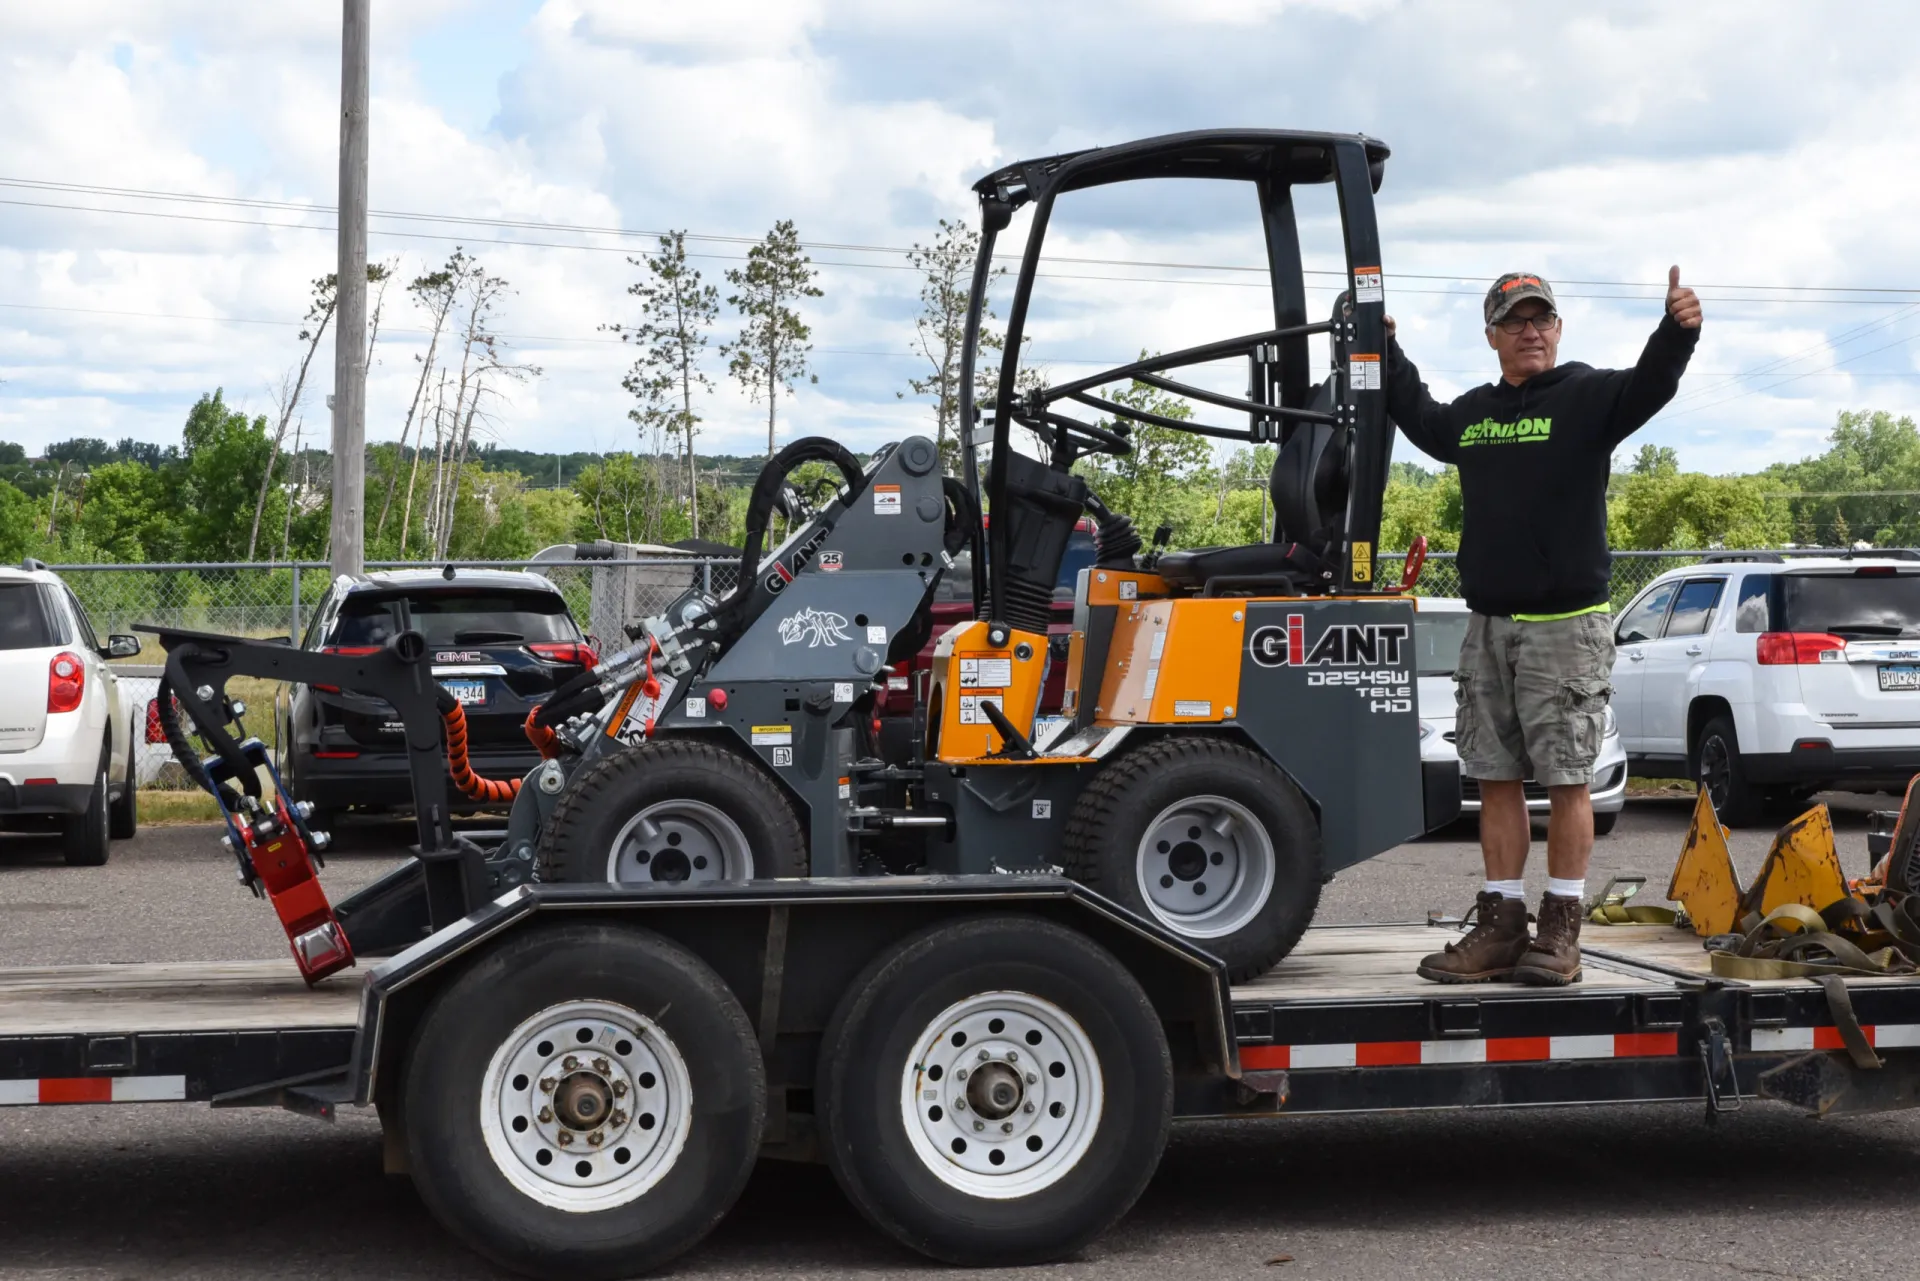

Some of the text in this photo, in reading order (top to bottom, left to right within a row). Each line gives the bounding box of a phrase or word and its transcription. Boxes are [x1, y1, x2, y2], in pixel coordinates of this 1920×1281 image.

[823, 554, 839, 564] 25
[436, 651, 481, 662] GMC
[1889, 651, 1918, 659] GMC
[1881, 672, 1900, 684] BYU
[463, 686, 483, 699] 344
[1356, 687, 1411, 697] TELE
[1370, 700, 1412, 713] HD
